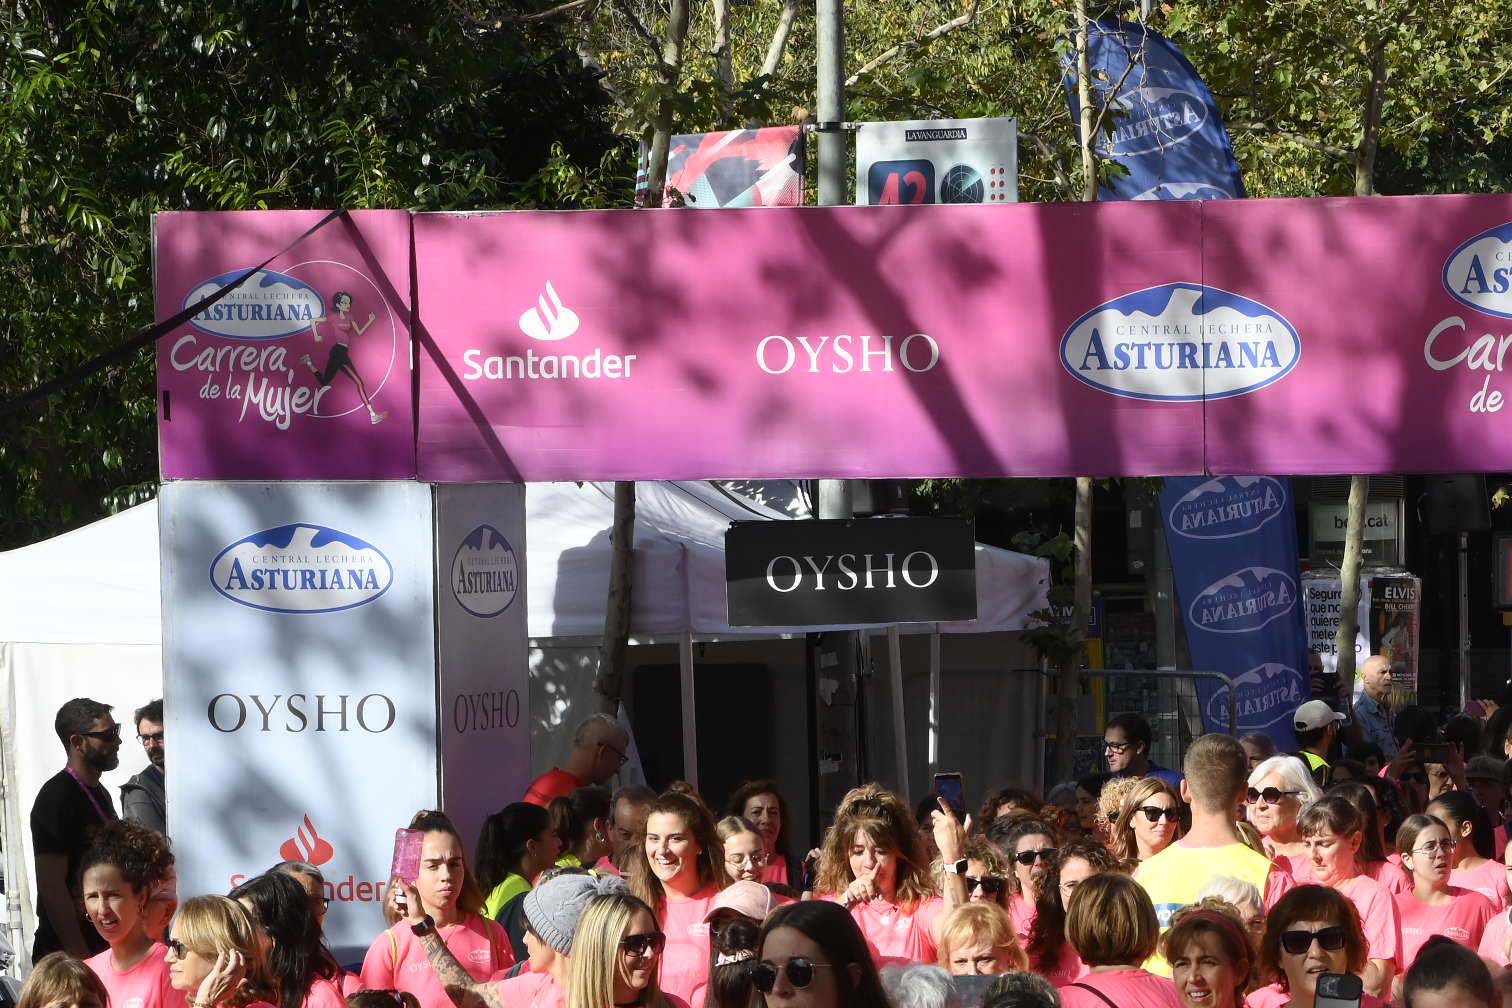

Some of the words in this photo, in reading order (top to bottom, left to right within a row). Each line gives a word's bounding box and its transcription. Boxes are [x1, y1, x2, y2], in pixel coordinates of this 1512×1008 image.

[916, 129, 967, 141] VANGUARDIA
[195, 294, 313, 321] ASTURIANA
[1116, 324, 1191, 336] CENTRAL
[1198, 322, 1273, 335] LECHERA
[170, 335, 288, 372] Carrera
[464, 350, 636, 381] Santander
[756, 334, 940, 375] OYSHO
[1080, 328, 1282, 371] ASTURIANA
[200, 376, 221, 400] de
[226, 374, 241, 400] la
[239, 369, 331, 430] Mujer
[1470, 374, 1503, 413] de
[225, 557, 381, 591] ASTURIANA
[252, 555, 310, 564] CENTRAL
[457, 559, 515, 594] ASTURIANA
[766, 550, 939, 593] OYSHO
[1384, 586, 1416, 600] ELVIS
[207, 693, 396, 733] OYSHO
[454, 689, 520, 733] OYSHO
